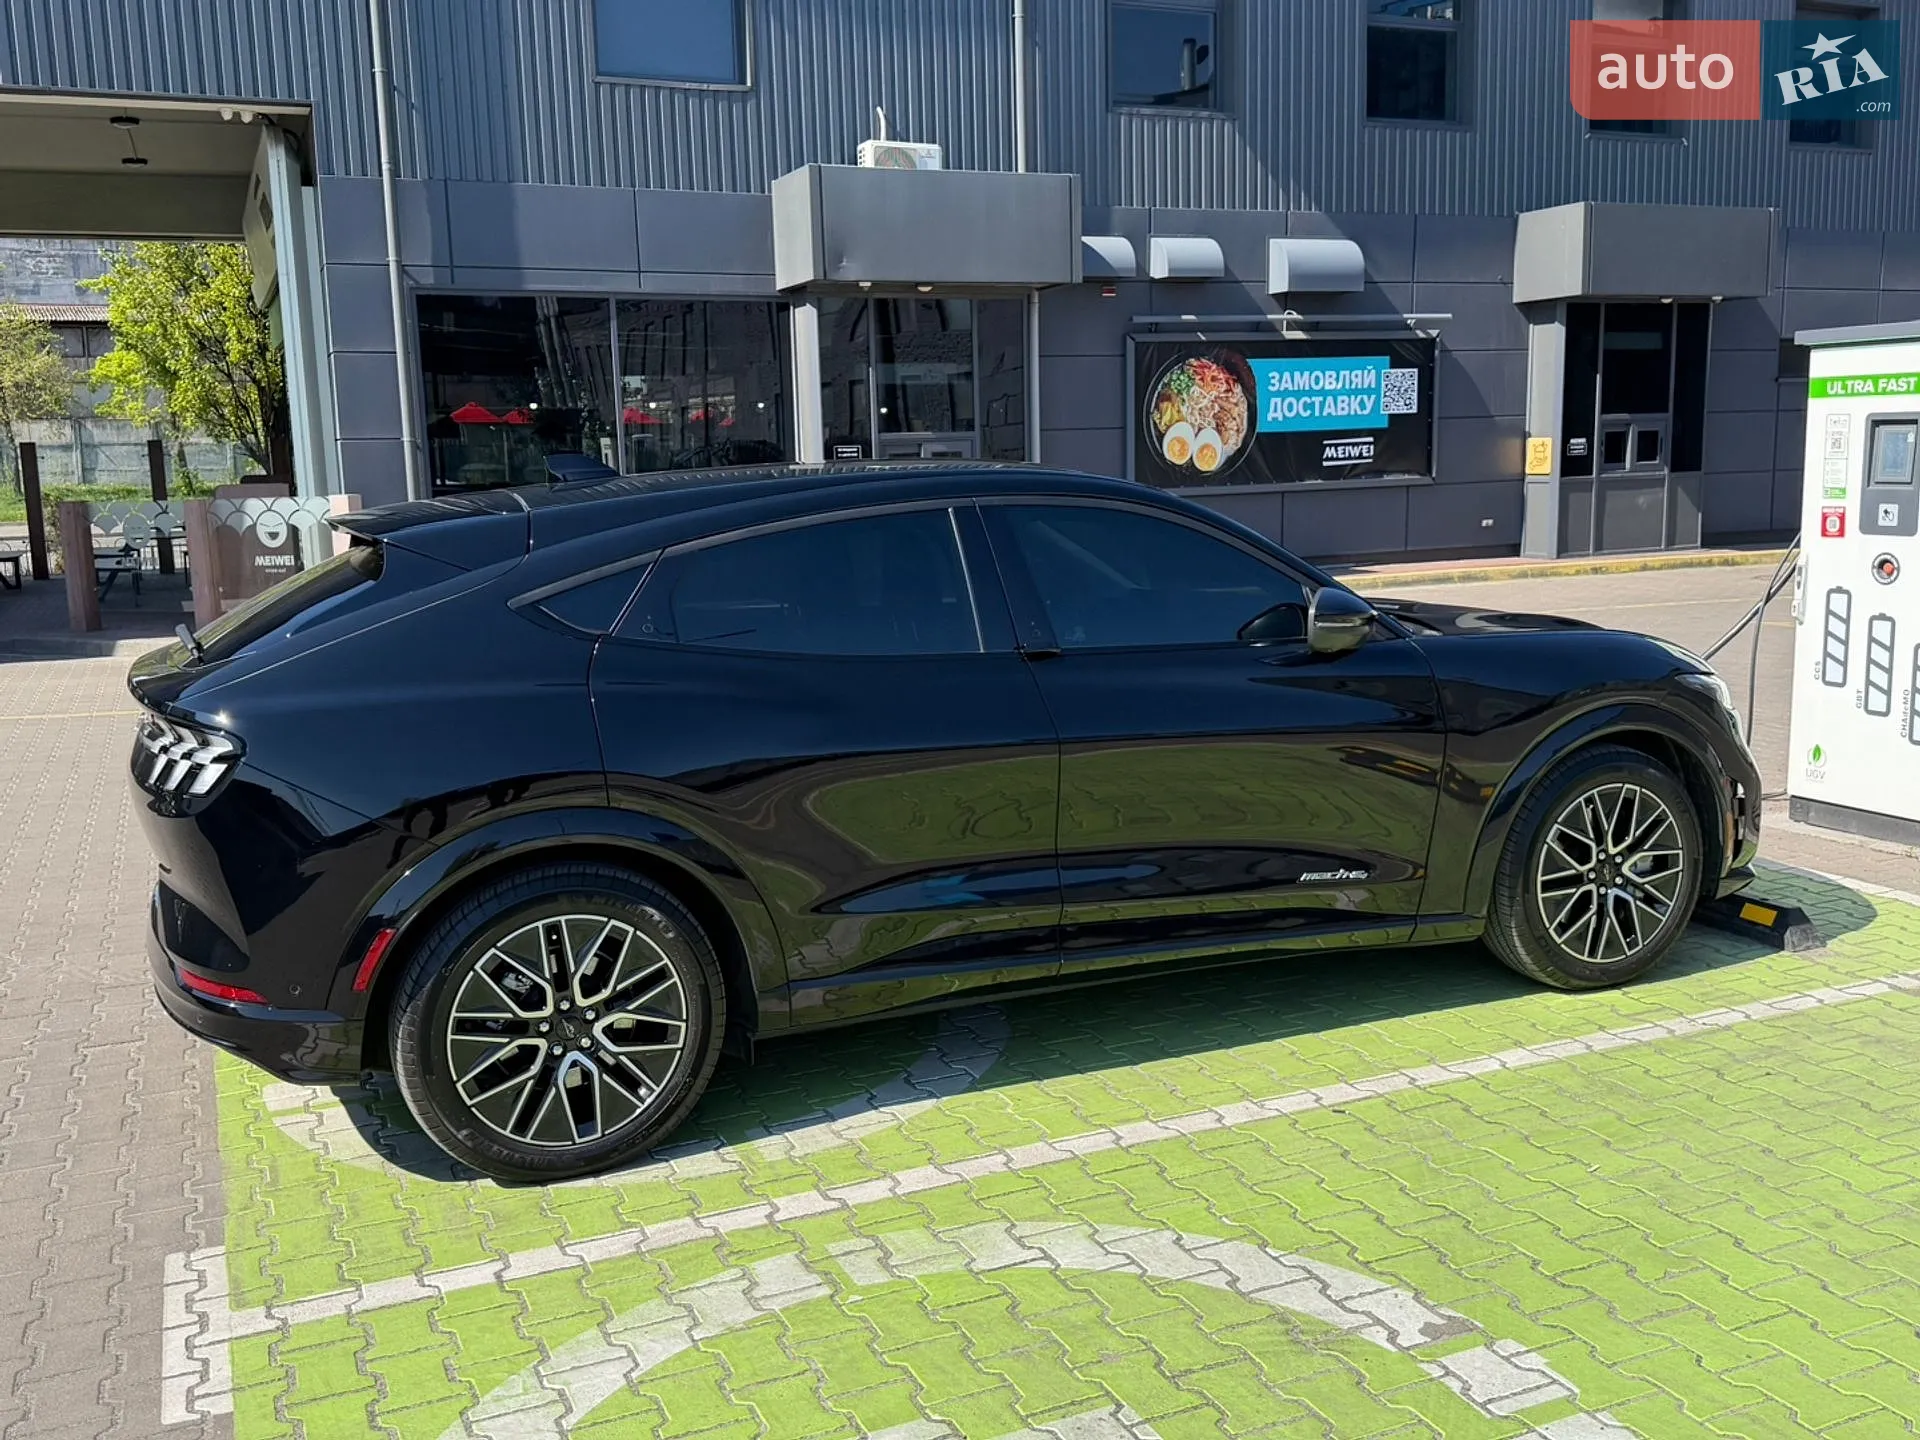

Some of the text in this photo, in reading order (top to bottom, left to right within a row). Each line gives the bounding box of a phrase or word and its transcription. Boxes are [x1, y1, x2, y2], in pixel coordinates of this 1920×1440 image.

[1268, 365, 1376, 391] ЗАМОВЛЯЙ
[1827, 377, 1917, 395] ULTRA FAST
[1268, 394, 1376, 421] ДОСТАВКУ
[1322, 444, 1375, 459] MEIWEI
[254, 554, 295, 567] MEIWEI
